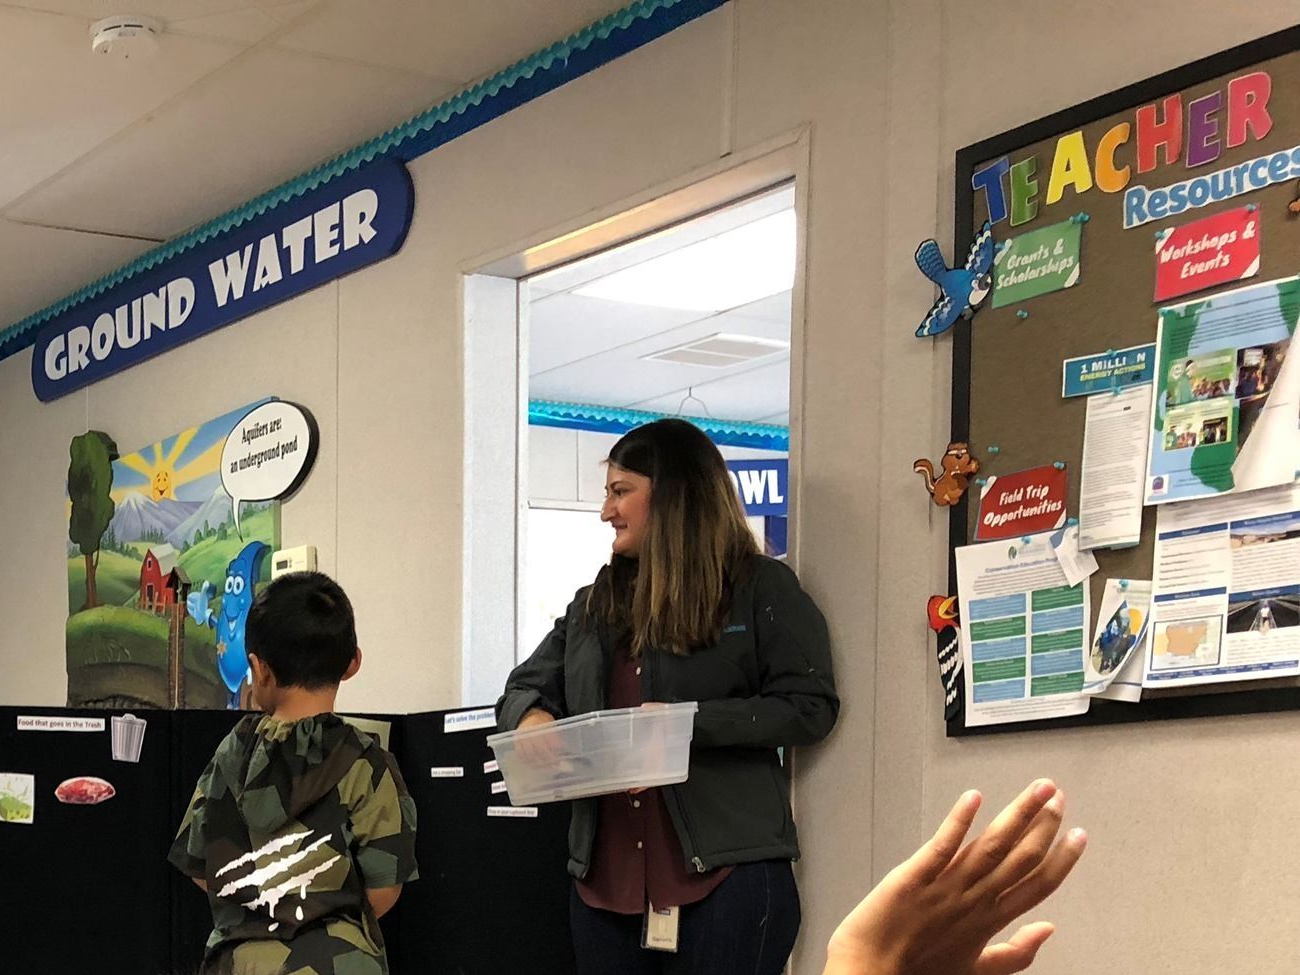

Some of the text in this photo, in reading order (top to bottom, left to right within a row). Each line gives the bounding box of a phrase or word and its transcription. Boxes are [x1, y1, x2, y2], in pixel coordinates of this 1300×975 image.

[971, 71, 1273, 226] TEACHER
[1124, 147, 1300, 227] Resources
[1007, 238, 1064, 270] Grants &
[1160, 221, 1255, 264] Workshops &
[996, 256, 1074, 290] Scholarships
[1180, 250, 1230, 279] Events
[44, 188, 379, 381] GROUND WATER
[242, 418, 282, 445] Aquifers are:
[230, 434, 298, 473] an underground pond
[999, 484, 1050, 506] Field Trip
[983, 500, 1062, 528] Opportunities
[35, 719, 48, 727] that
